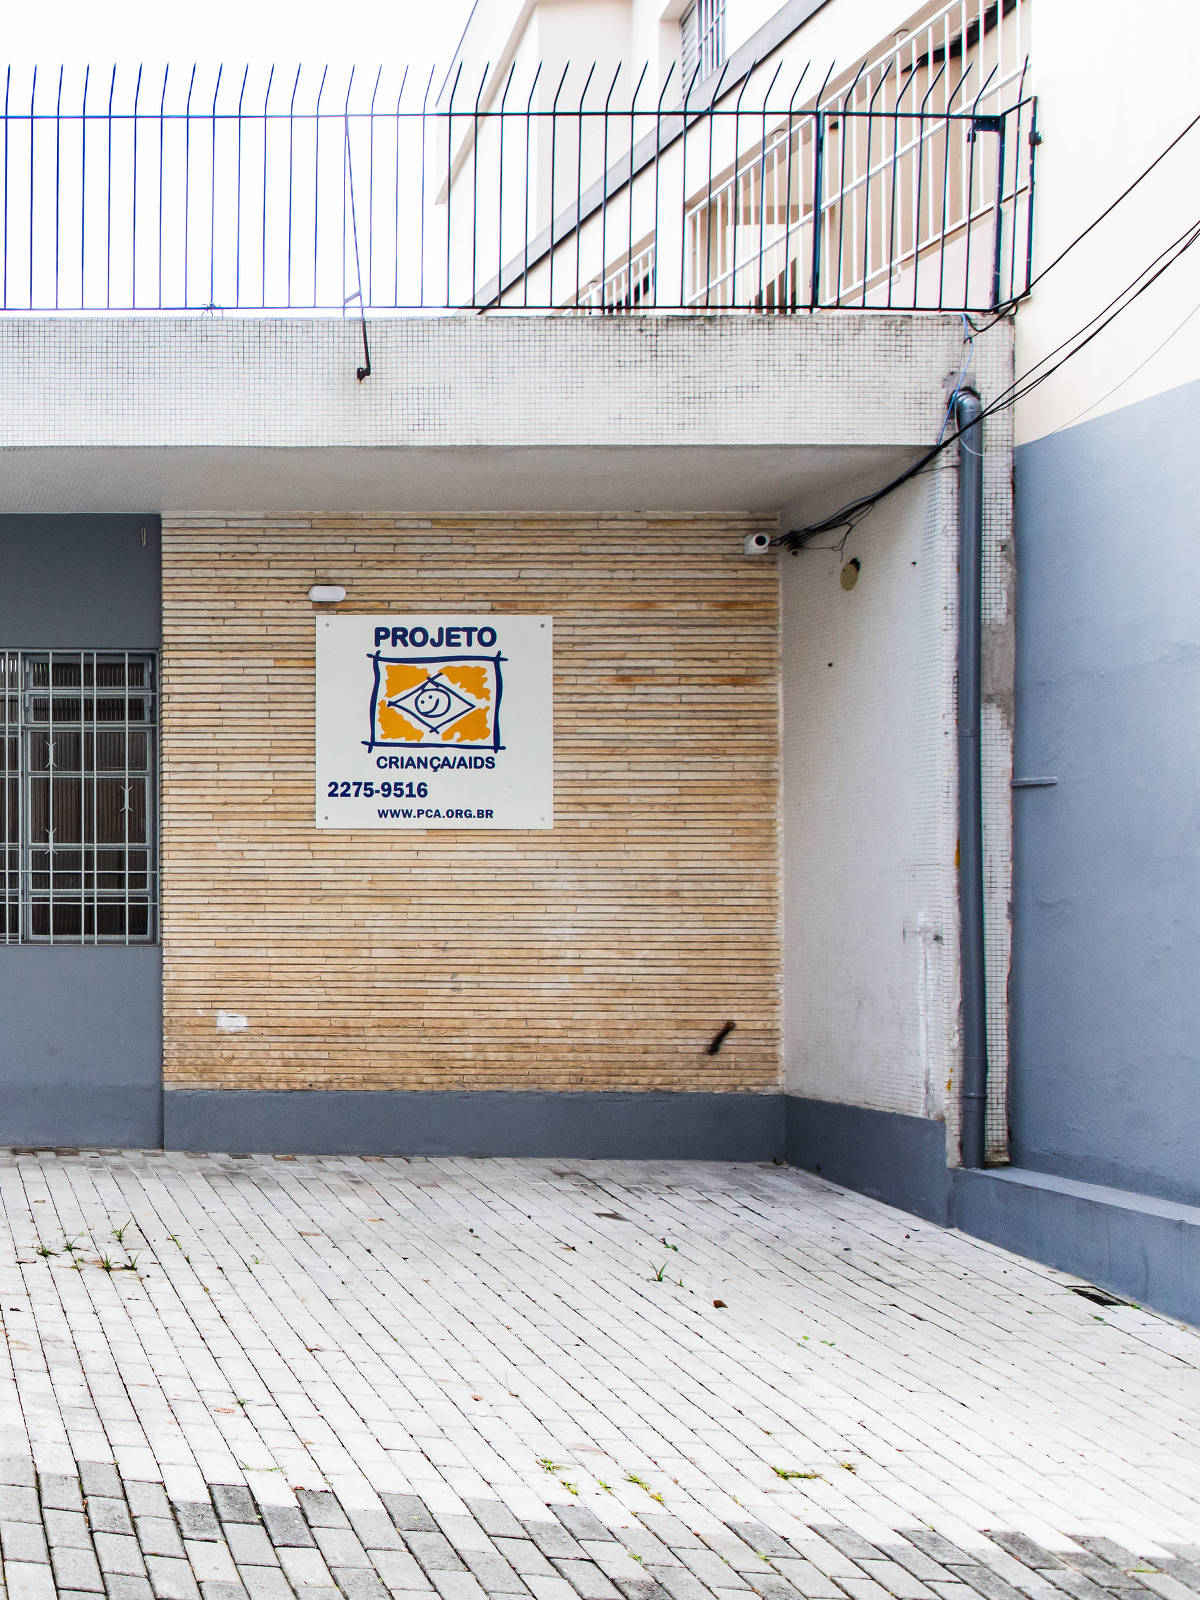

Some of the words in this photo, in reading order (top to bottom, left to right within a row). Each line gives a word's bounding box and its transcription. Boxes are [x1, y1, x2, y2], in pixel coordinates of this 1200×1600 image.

[374, 626, 498, 648] PROJETO
[376, 756, 496, 772] CRIANÇA/AIDS
[327, 781, 429, 798] 2275-9516
[377, 809, 494, 819] WWW.PCA.ORG.BR
